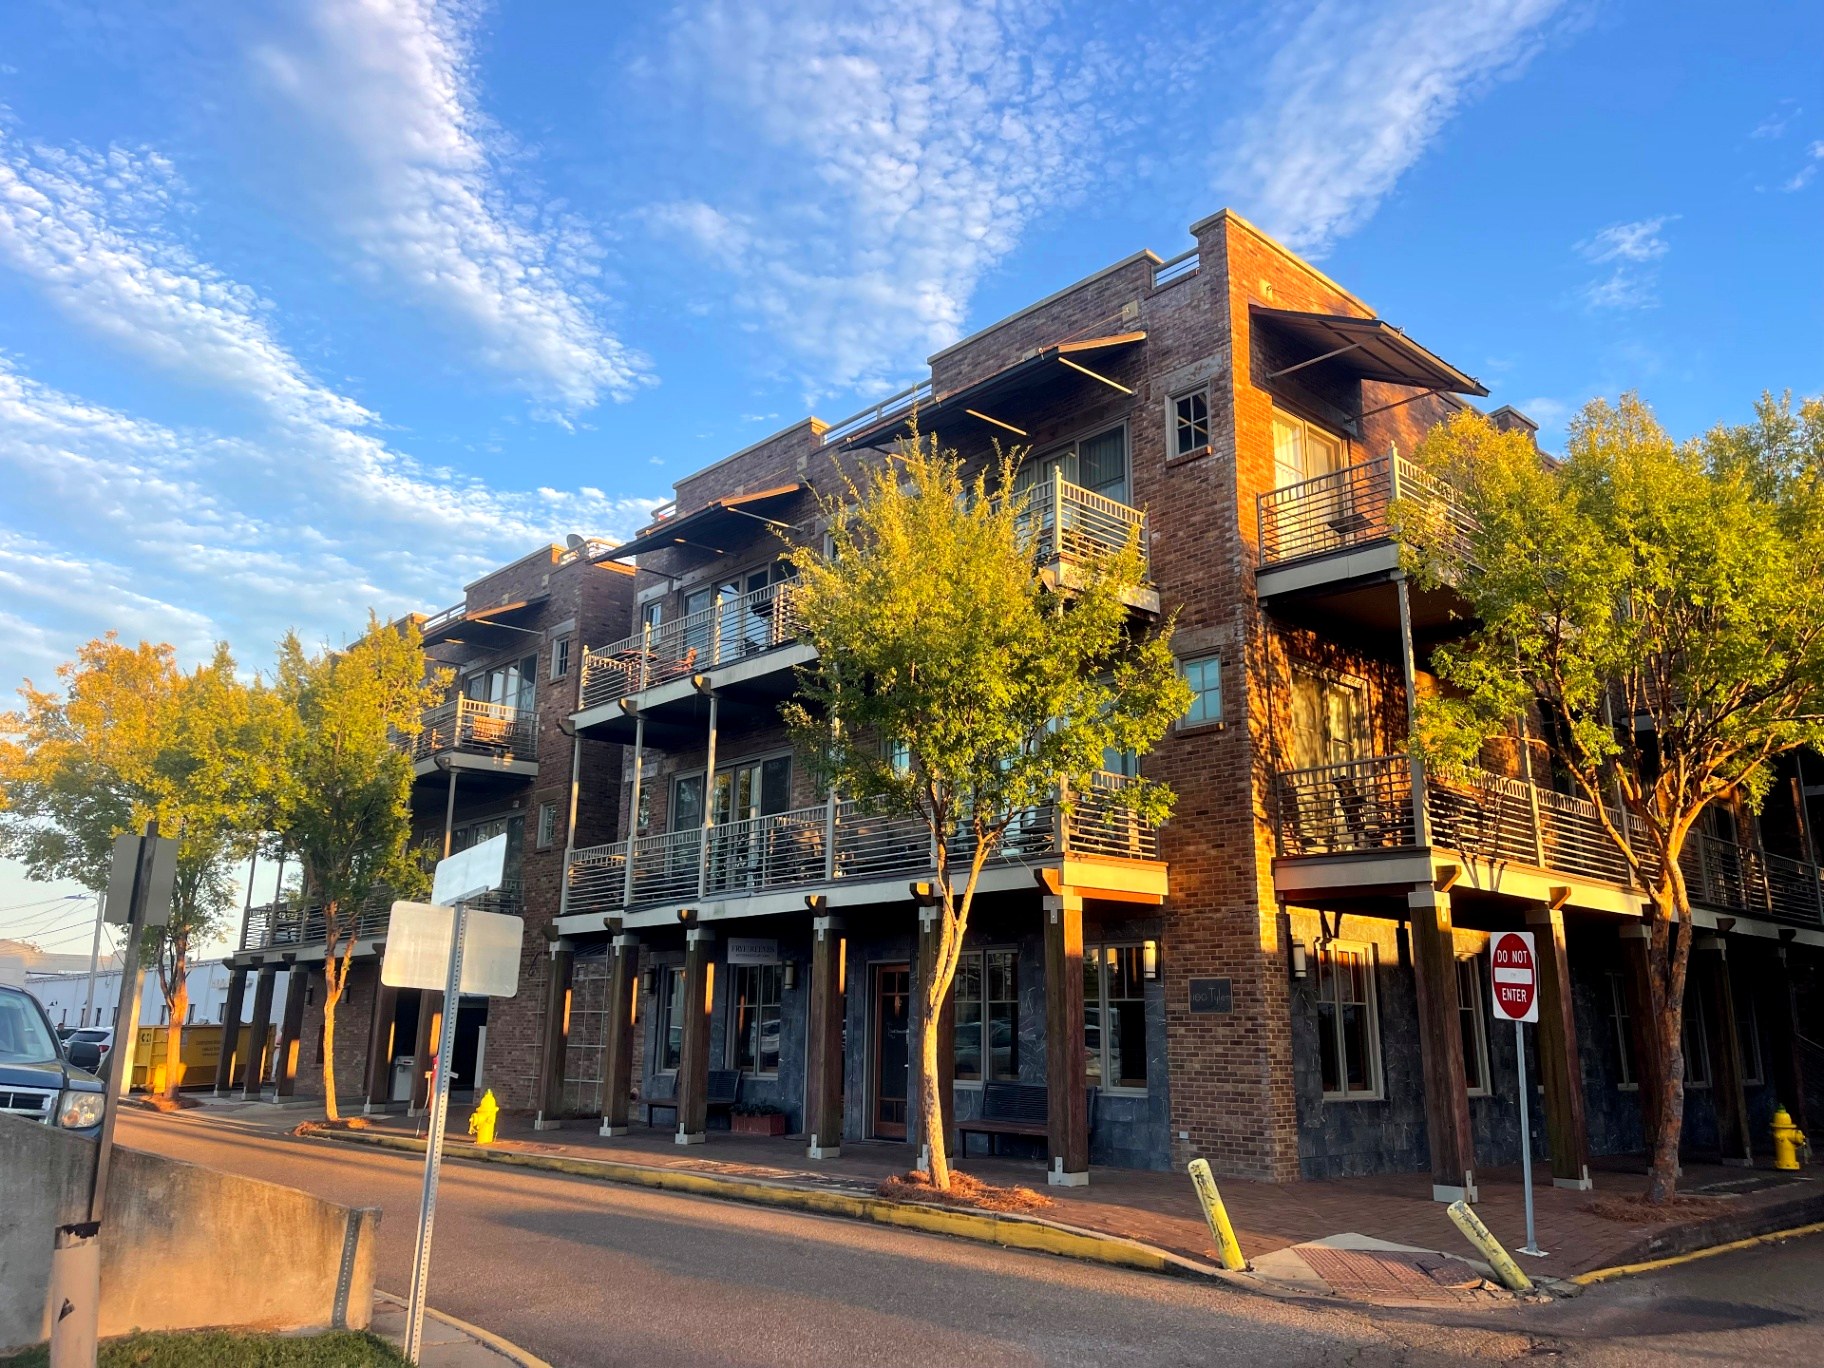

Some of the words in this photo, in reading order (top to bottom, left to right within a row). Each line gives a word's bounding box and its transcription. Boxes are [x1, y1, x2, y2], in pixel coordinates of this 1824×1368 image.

[1497, 950, 1508, 963] DO
[1512, 950, 1527, 963] NOT
[1502, 988, 1527, 1002] ENTER
